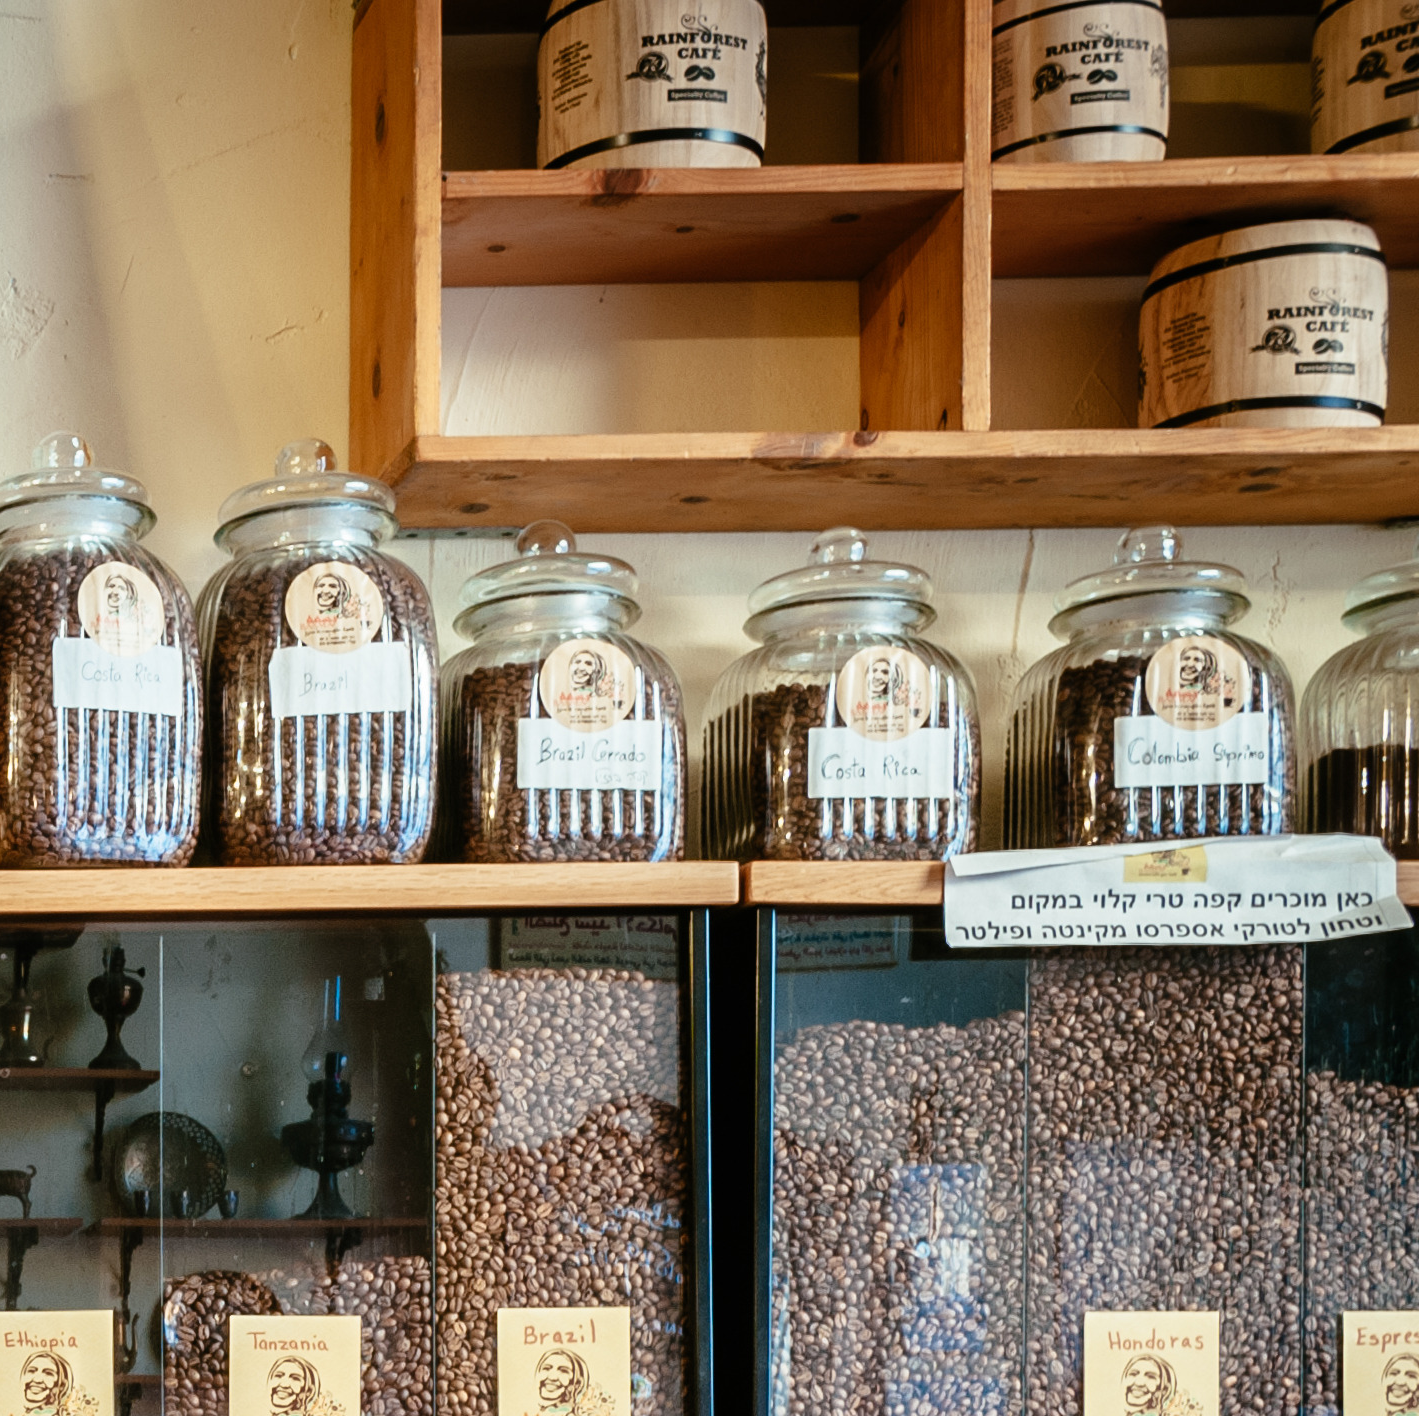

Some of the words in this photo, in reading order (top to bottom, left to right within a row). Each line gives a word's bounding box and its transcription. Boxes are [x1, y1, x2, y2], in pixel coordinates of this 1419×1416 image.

[642, 31, 748, 50] RAINFOREST
[1045, 36, 1150, 58] RAINFOREST
[678, 46, 721, 60] CAFÉ
[1080, 50, 1124, 65] CAFÉ
[1267, 304, 1374, 321] RAINFOREST
[1305, 320, 1349, 333] CAFÉ
[81, 660, 122, 683] Costa
[135, 661, 161, 689] Rica
[299, 669, 348, 697] Brazil
[536, 737, 586, 766] Brazil
[592, 738, 647, 763] Cerrado
[1128, 737, 1200, 765] Colombia
[821, 753, 866, 780] Costa
[883, 754, 922, 780] Rica
[1011, 894, 1083, 914] במקום
[1093, 889, 1136, 913] קלוי
[1146, 893, 1184, 909] טרי
[1193, 893, 1242, 912] קפה
[1251, 892, 1327, 909] מוכרים
[1337, 891, 1373, 912] כאן
[955, 921, 1031, 941] ופילטר
[1042, 924, 1127, 943] מקינטה
[1136, 923, 1225, 939] אספרסו
[1233, 918, 1310, 941] לטורקי
[1321, 915, 1384, 938] וטחון
[4, 1331, 78, 1352] Ethiopia
[246, 1331, 329, 1351] Tanzania
[524, 1318, 596, 1345] Brazil
[1108, 1328, 1204, 1350] Hondoras
